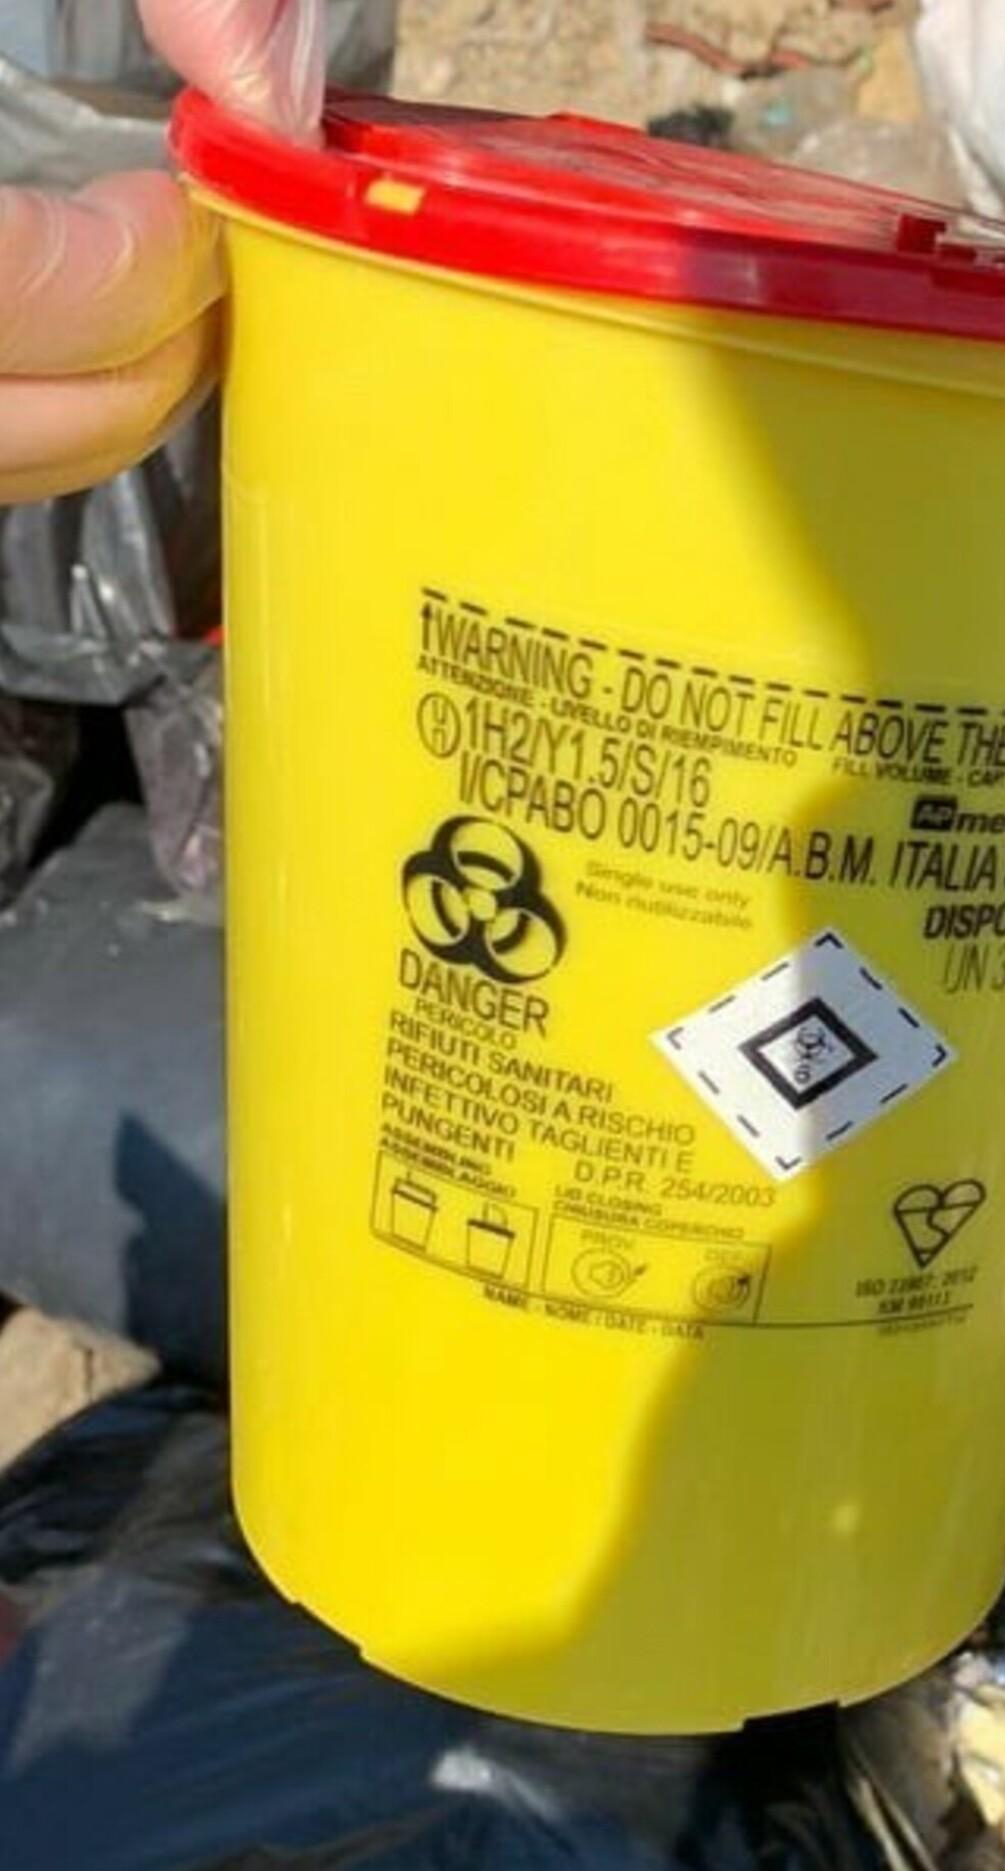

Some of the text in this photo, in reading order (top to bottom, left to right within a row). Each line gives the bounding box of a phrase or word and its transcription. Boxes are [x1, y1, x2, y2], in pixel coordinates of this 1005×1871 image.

[416, 655, 534, 708] ATTENZIONE
[551, 697, 632, 734] LIVELLO
[636, 720, 656, 741] DI
[661, 723, 798, 768] RIEMPIMENTO
[437, 607, 594, 700] WARNING
[621, 666, 671, 719] DO
[681, 680, 756, 737] NOT
[759, 697, 823, 751] FILL
[830, 711, 949, 764] ABOVE
[465, 696, 713, 809] 1H2/Y1.5/S/16
[833, 760, 868, 778] FILL
[875, 763, 952, 785] VOLUME
[459, 749, 607, 841] I/CPABO
[890, 840, 997, 892] ITALIA
[399, 947, 551, 1038] DANGER
[942, 944, 989, 994] UN
[390, 1009, 613, 1101] RIFIUTI SANITARI
[413, 997, 518, 1051] PERICOLO
[381, 1091, 515, 1163] PUNGENTI
[384, 1064, 695, 1173] INFETTIVO TAGLIENTI E
[387, 1036, 696, 1145] PERICOLOSI A RISCHIO
[661, 1176, 777, 1209] 254/2003
